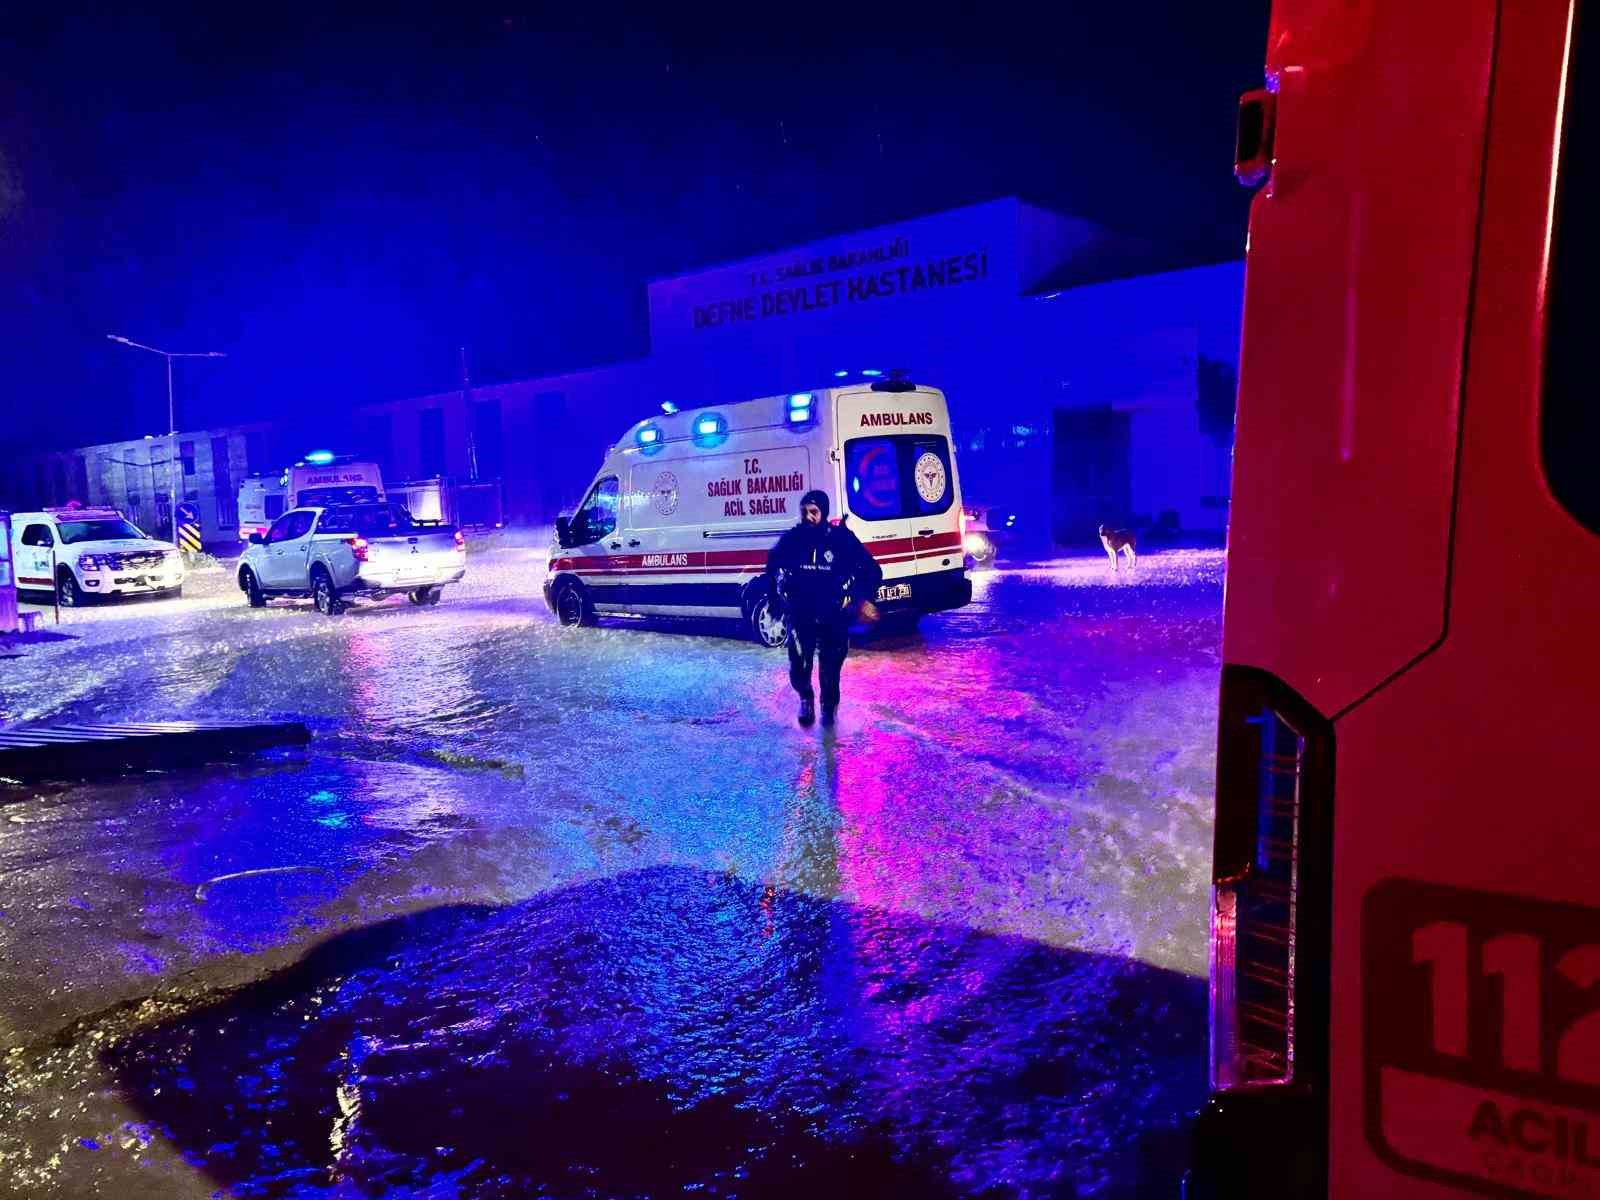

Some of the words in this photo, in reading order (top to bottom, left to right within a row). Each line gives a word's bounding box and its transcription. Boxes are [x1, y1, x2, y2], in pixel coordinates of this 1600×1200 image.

[760, 282, 840, 317] DEVLET
[847, 247, 988, 302] HASTANESİ
[861, 412, 933, 427] AMBULANS
[744, 458, 762, 474] T.C.
[708, 477, 742, 497] SAĞLIK
[747, 471, 803, 494] BAKANLIĞI
[724, 497, 746, 516] ACİL
[749, 495, 787, 515] SAĞLIK
[641, 553, 688, 567] AMBULANS
